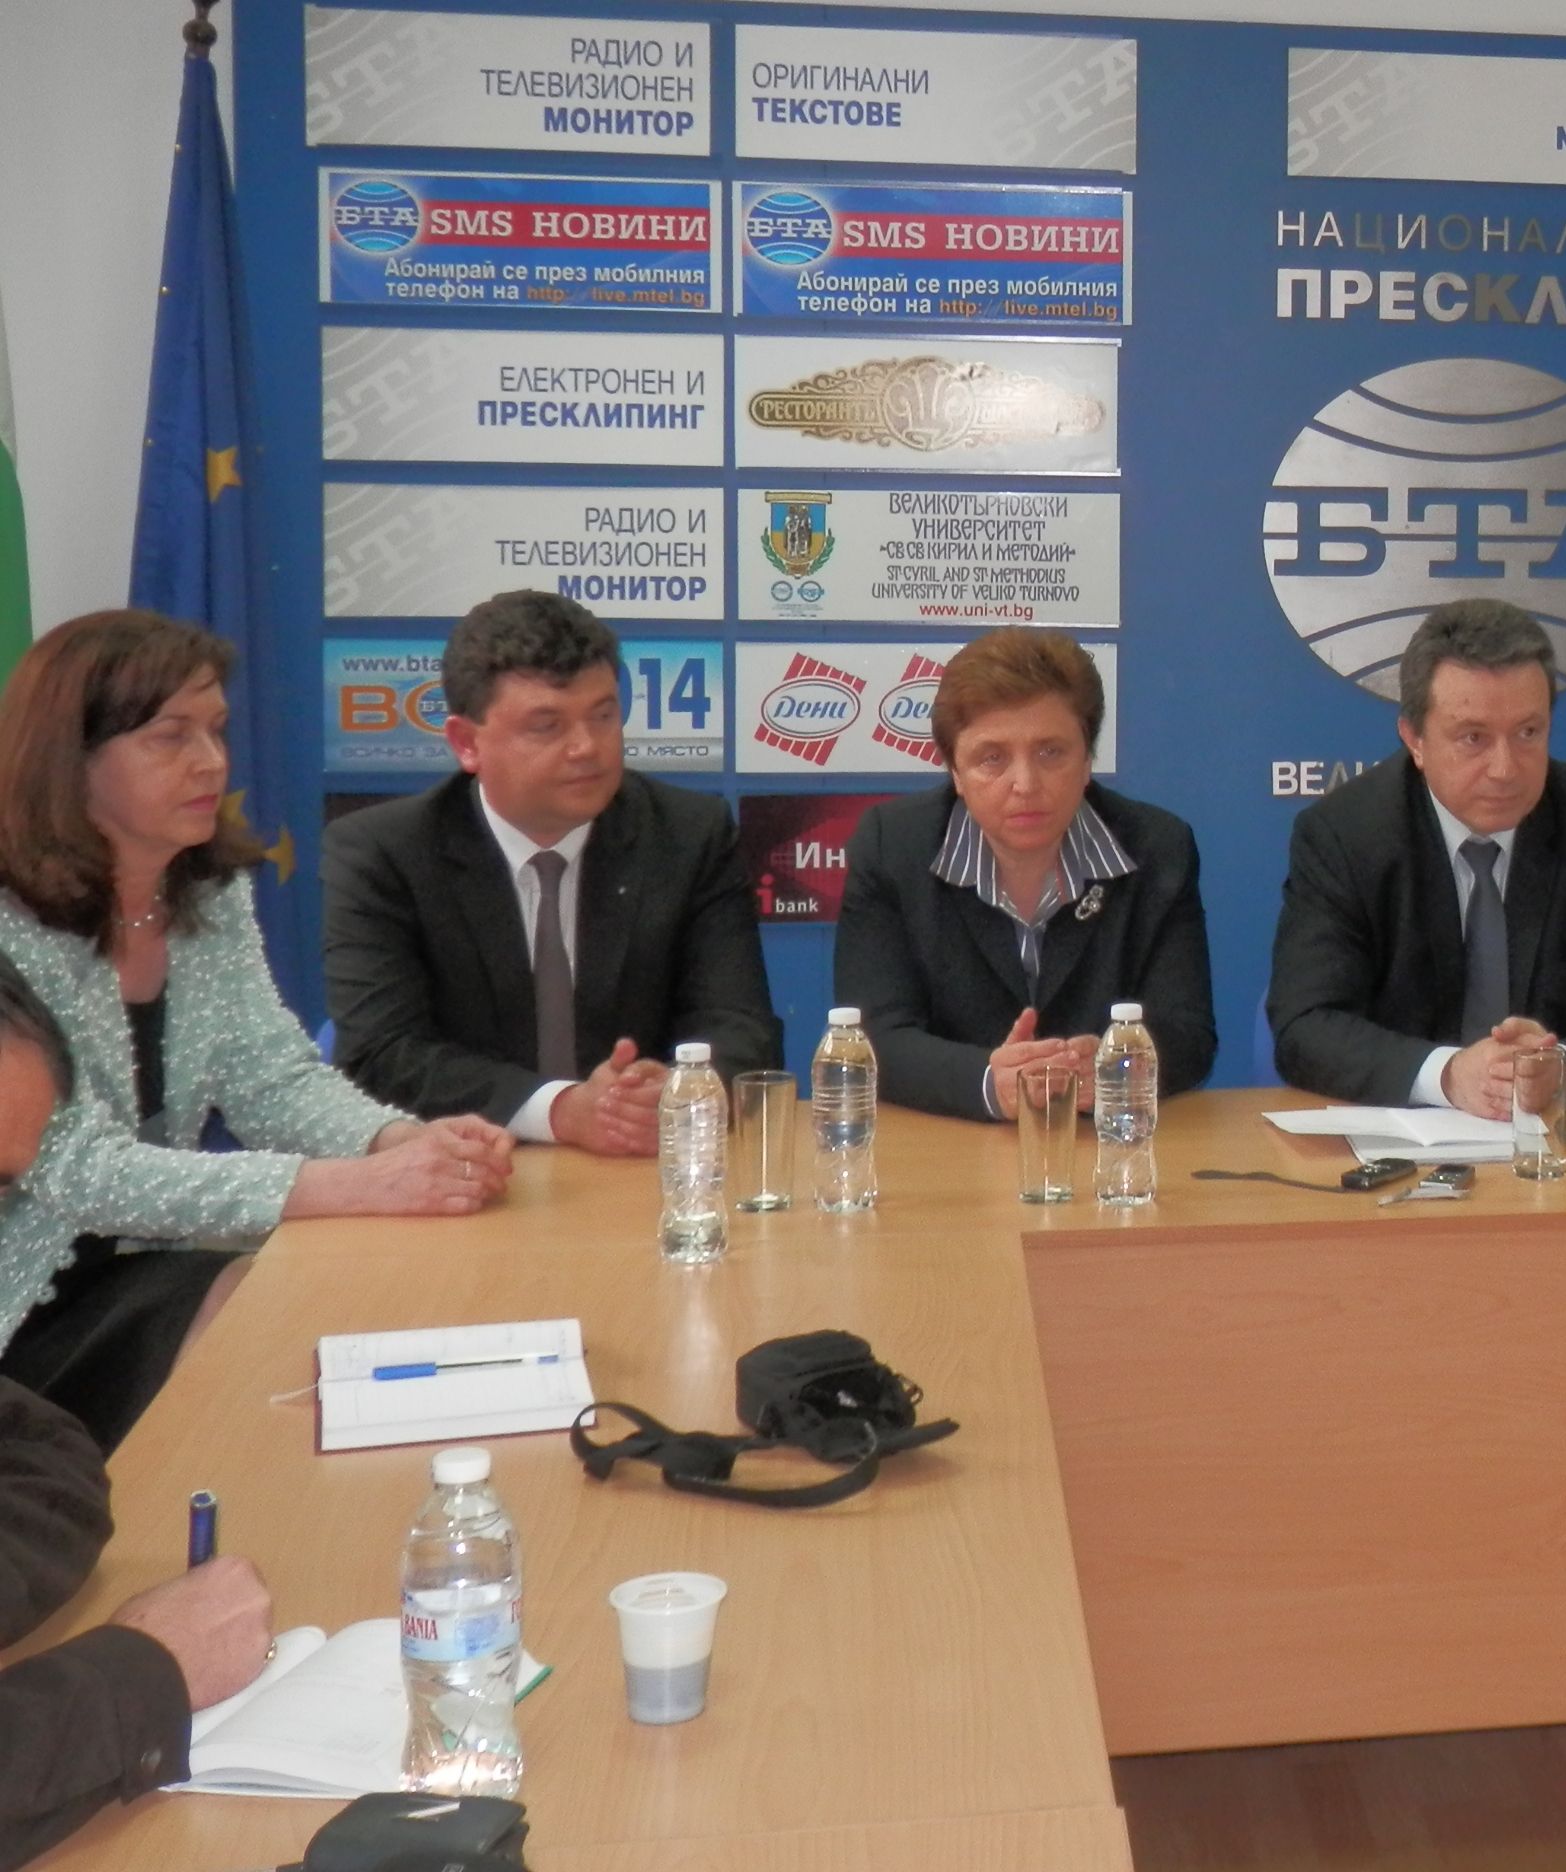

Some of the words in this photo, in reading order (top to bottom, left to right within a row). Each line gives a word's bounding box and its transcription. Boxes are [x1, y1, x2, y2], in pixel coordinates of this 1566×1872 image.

[571, 38, 662, 67] РАДИО
[675, 43, 693, 67] И
[481, 69, 693, 102] ТЕЛЕВИЗИОНЕН
[752, 62, 929, 95] ОРИГИНАЛНИ
[543, 107, 693, 136] МОНИТОР
[752, 97, 901, 127] ТЕКСТОВЕ
[336, 206, 418, 228] БТА
[431, 209, 512, 237] SMS
[532, 212, 707, 242] НОВИНИ
[747, 218, 830, 239] БТА
[843, 221, 926, 250] SMS
[945, 223, 1119, 254] НОВИНИ
[385, 257, 495, 281] Абонирай
[503, 265, 528, 280] се
[536, 267, 587, 285] през
[595, 264, 704, 284] мобилния
[386, 280, 484, 302] телефон
[494, 286, 519, 300] на
[797, 270, 907, 295] Абонирай
[916, 279, 939, 294] се
[948, 281, 999, 299] през
[1007, 277, 1117, 298] мобилния
[798, 293, 897, 316] телефон
[906, 299, 931, 313] на
[501, 367, 674, 395] ЕЛЕКТРОНЕН
[687, 370, 704, 395] И
[478, 400, 705, 430] ПРЕСКЛИПИНГ
[889, 492, 1068, 517] ВЕЛИКОТЪРНОВСКИ
[585, 507, 676, 537] РАДИО
[688, 509, 706, 533] И
[912, 518, 1046, 542] УНИВЕРСИТЕТ
[496, 540, 706, 567] ТЕЛЕВИЗИОНЕН
[927, 542, 978, 560] КИРИЛ
[982, 543, 992, 560] И
[558, 575, 707, 600] МОНИТОР
[904, 566, 940, 582] CYRIL
[943, 566, 970, 582] AND
[991, 567, 1066, 584] METHODIUS
[872, 583, 947, 599] UNIVERSITY
[952, 584, 968, 599] OF
[972, 585, 1016, 600] VELIKO
[1019, 585, 1080, 601] TURNOVO
[920, 603, 1033, 621] www.uni-vt.bg
[343, 655, 442, 672] www.bta
[774, 696, 848, 719] Дени
[647, 745, 709, 757] МЯСТО
